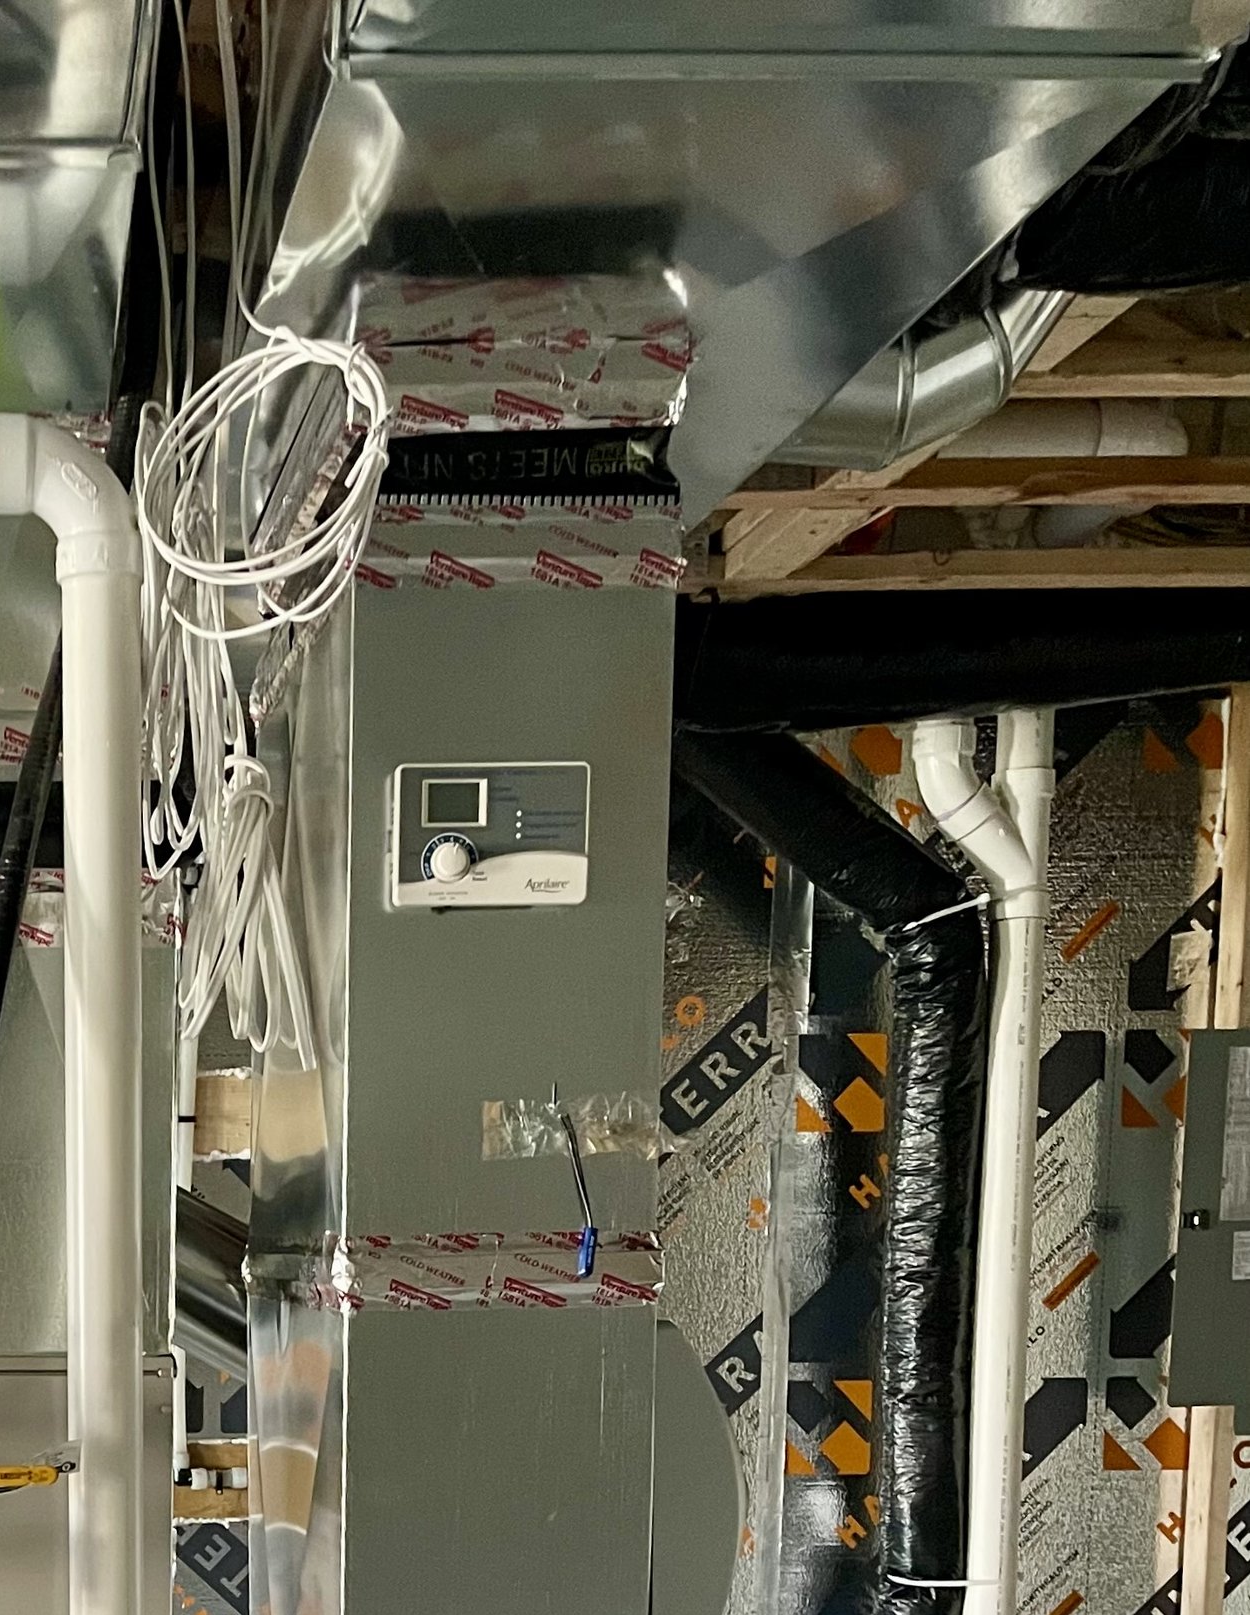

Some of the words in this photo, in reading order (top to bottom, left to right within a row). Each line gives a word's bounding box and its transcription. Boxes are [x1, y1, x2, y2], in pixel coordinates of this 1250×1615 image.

[525, 878, 570, 892] Aprilaire
[400, 1255, 424, 1269] COLD
[426, 1265, 466, 1286] WEATHER
[514, 1253, 539, 1267] COLD
[390, 1281, 452, 1310] VentureTape
[504, 1279, 567, 1308] VentureTape
